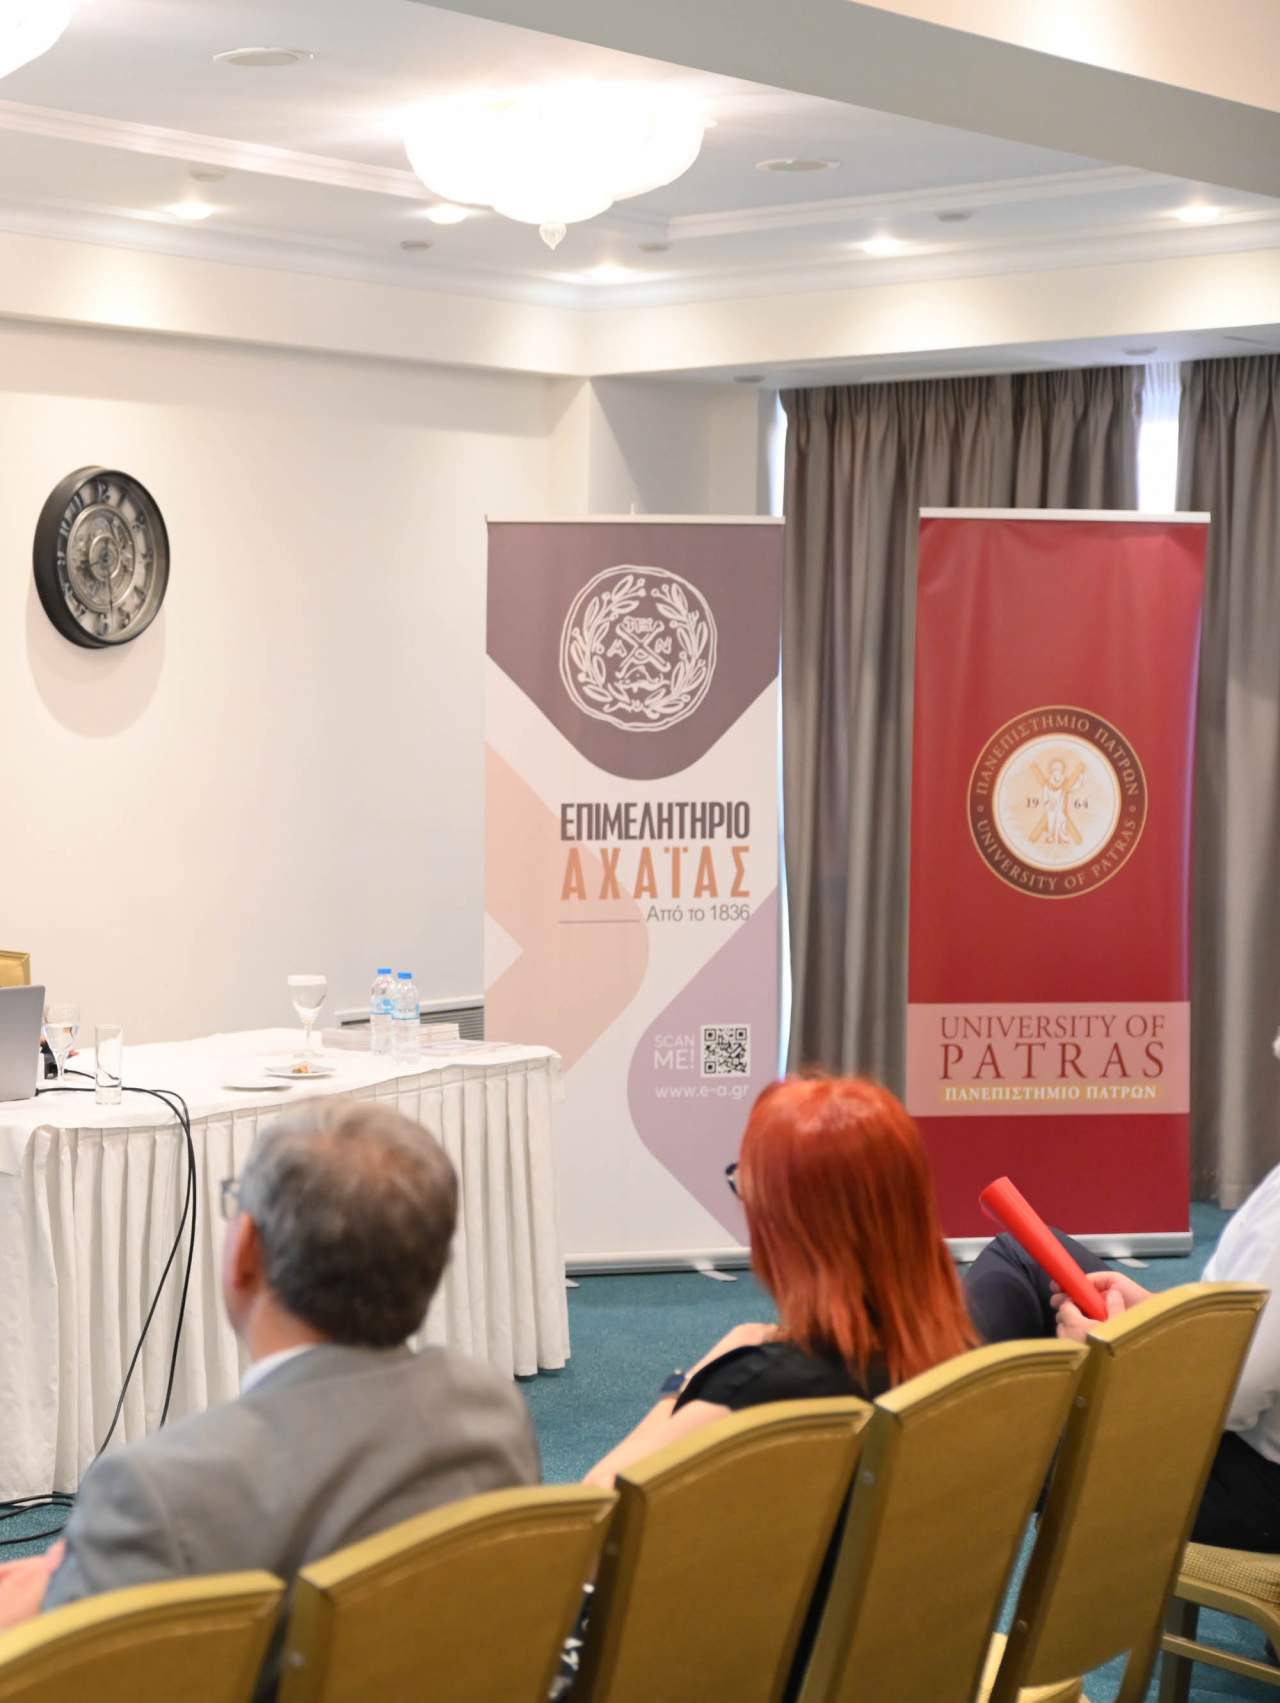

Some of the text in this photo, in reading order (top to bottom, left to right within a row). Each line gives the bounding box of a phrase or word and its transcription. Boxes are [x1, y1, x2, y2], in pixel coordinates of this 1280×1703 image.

[976, 713, 1139, 796] ΠΑΝΕΠΙΣΤΗΜΙΟ ΠΑΤΡΩΝ
[560, 801, 751, 841] ΕΠΙΜΕΛΗΤΗΡΙΟ
[977, 819, 1137, 891] UNIVERSITY OF PATRAS
[560, 845, 751, 901] ΑΧΑΪΑΣ
[646, 903, 751, 922] Από το 1836
[940, 1014, 1165, 1039] UNIVERSITY OF
[654, 1034, 695, 1048] SCAN
[654, 1049, 695, 1070] ME!
[938, 1041, 1165, 1080] PATRAS
[655, 1084, 750, 1100] www.e-a.gr
[944, 1084, 1157, 1101] ΠΑΝΕΠΙΣΤΗΜΙΟ ΠΑΤΡΩΝ
